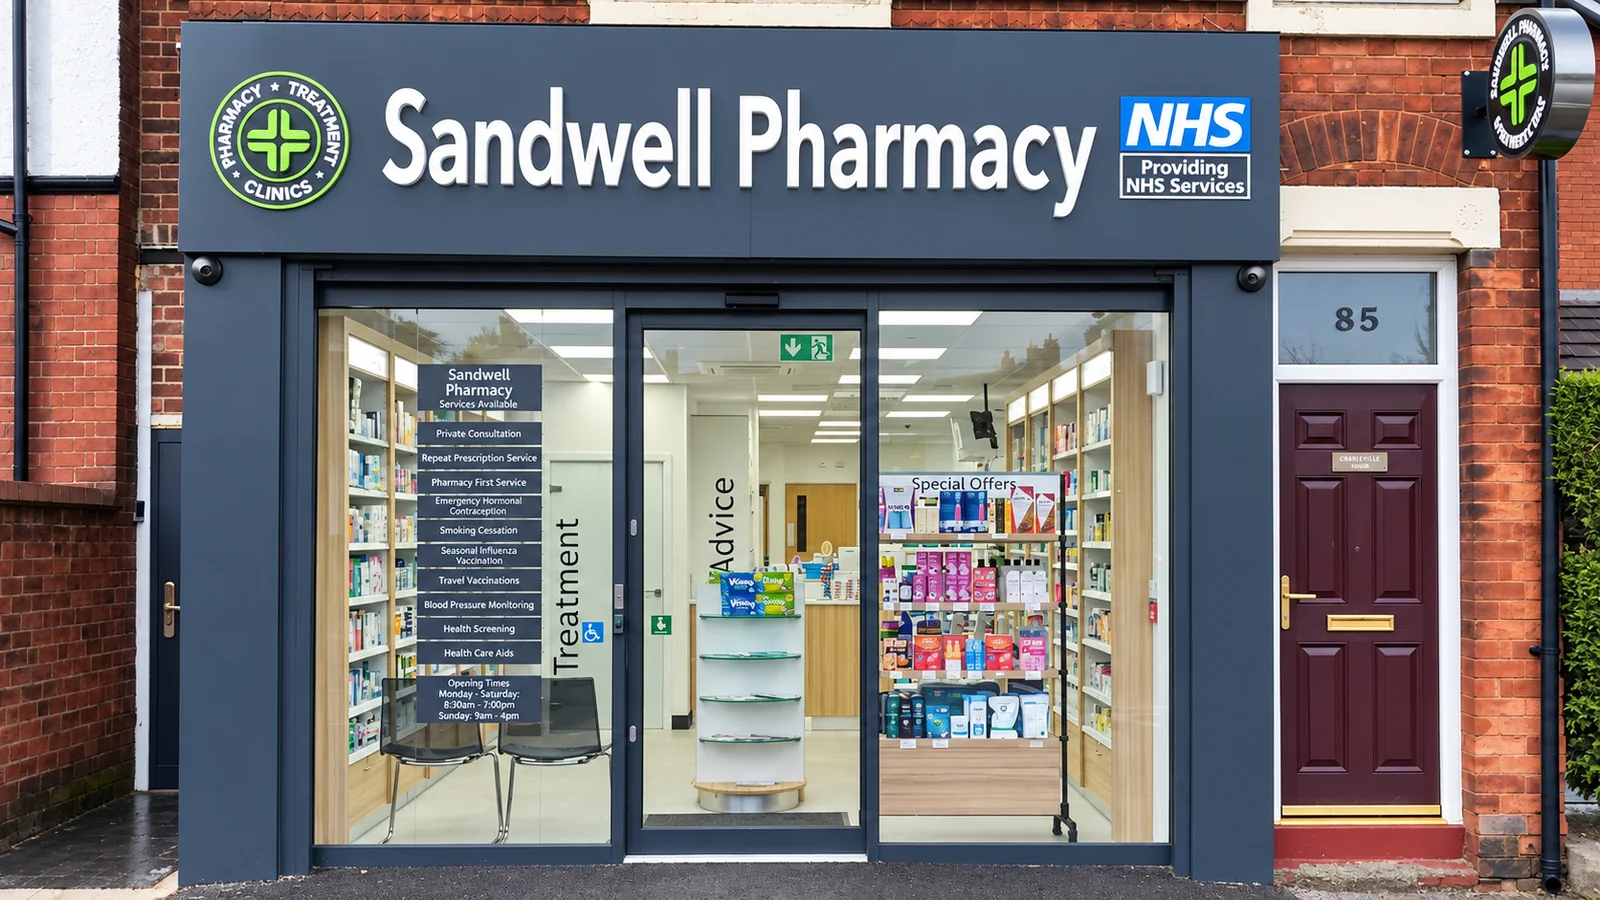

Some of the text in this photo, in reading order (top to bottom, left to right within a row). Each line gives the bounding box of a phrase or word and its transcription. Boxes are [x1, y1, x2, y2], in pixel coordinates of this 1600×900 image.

[217, 83, 262, 170] PHARMACY
[288, 80, 341, 168] TREATMENT
[1125, 102, 1246, 148] NHS
[381, 86, 1098, 218] Sandwell Pharmacy
[1141, 159, 1229, 179] Providing
[244, 179, 313, 201] CLINICS
[1126, 178, 1245, 194] NHS Services
[1335, 306, 1379, 332] 85
[448, 367, 511, 381] Sandwell
[445, 382, 514, 401] Pharmacy
[439, 399, 518, 409] Services Available
[436, 429, 522, 438] Private Consultation
[421, 453, 538, 465] Repeat Prescription Service
[431, 478, 527, 489] Pharmacy First Service
[912, 477, 1016, 493] Special Offers
[435, 497, 523, 507] Emergency Hormonal
[708, 477, 734, 572] Advice
[439, 526, 518, 537] Smoking Cessation
[440, 546, 518, 555] Seasonal Influenza
[455, 557, 503, 565] Vaccination
[438, 576, 520, 585] Travel Vaccinations
[553, 518, 579, 676] Treatment
[424, 601, 535, 612] Blood Pressure Monitoring
[443, 625, 516, 636] Health Screening
[443, 649, 515, 658] Health Care Aids
[447, 679, 511, 690] Opening Times
[438, 690, 474, 701] Monday
[480, 690, 520, 701] Saturday:
[443, 701, 476, 710] 8:30am
[483, 701, 516, 711] 7:00pm
[438, 712, 473, 722] Sunday:
[474, 712, 493, 720] 9am
[499, 712, 520, 722] 4pm
